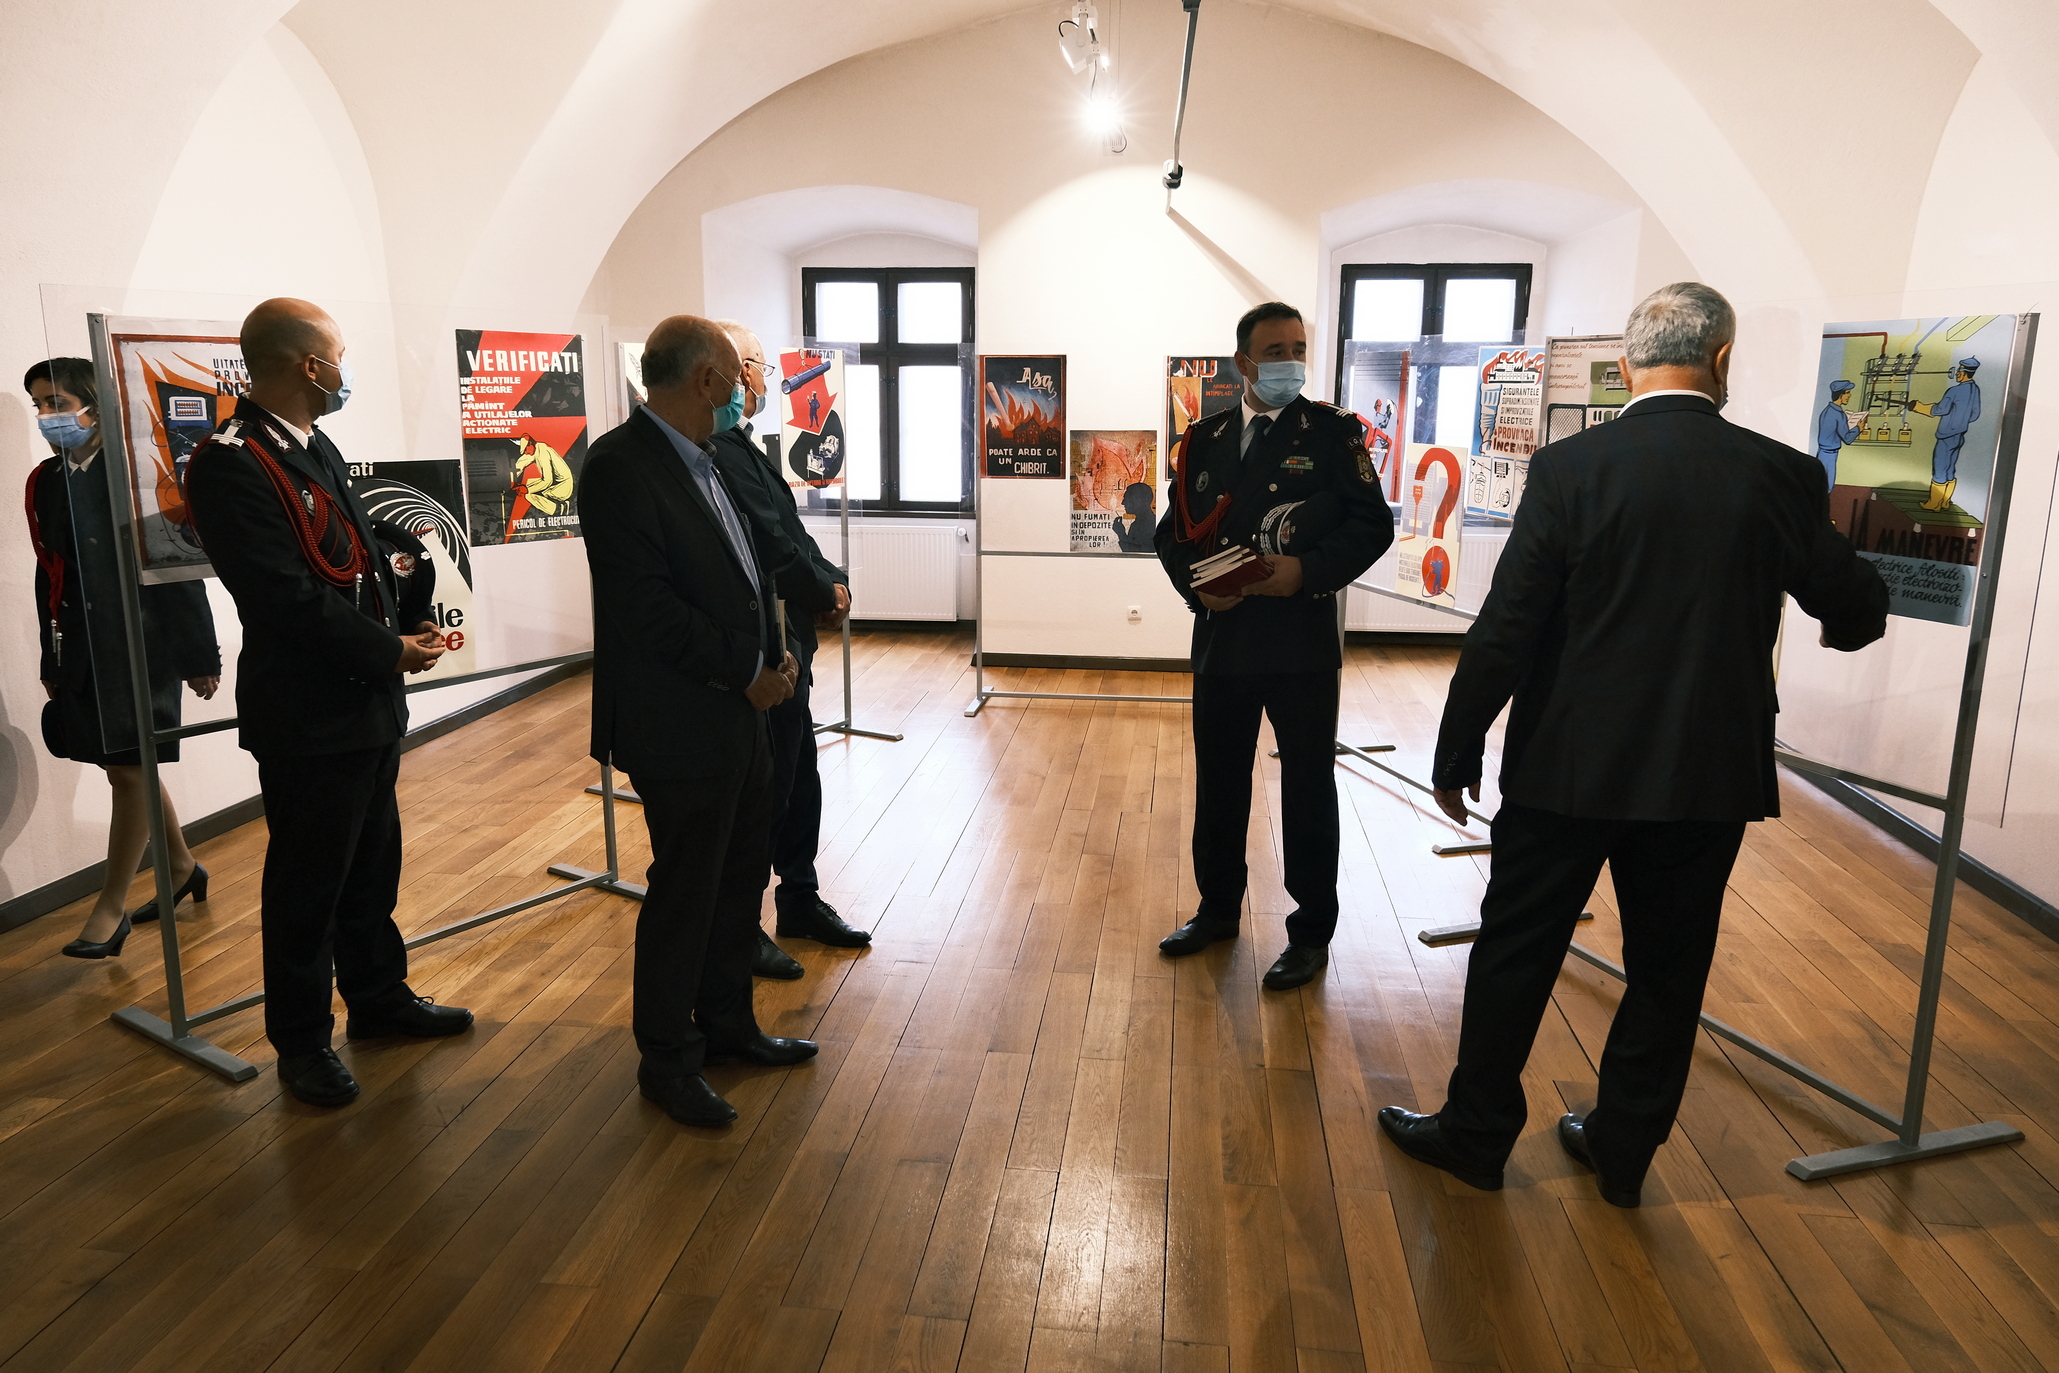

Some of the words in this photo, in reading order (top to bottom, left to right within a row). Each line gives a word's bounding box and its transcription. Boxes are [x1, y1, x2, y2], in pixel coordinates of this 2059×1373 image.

[806, 350, 817, 358] NU
[1180, 360, 1217, 377] NU
[461, 386, 472, 394] DE
[475, 386, 513, 394] LEGARE
[989, 448, 1013, 456] POATE
[1018, 448, 1042, 456] ARDE
[1046, 448, 1057, 456] CA
[512, 517, 537, 529] PERICOL
[538, 517, 546, 528] DE
[1875, 528, 1977, 566] MANEVRE
